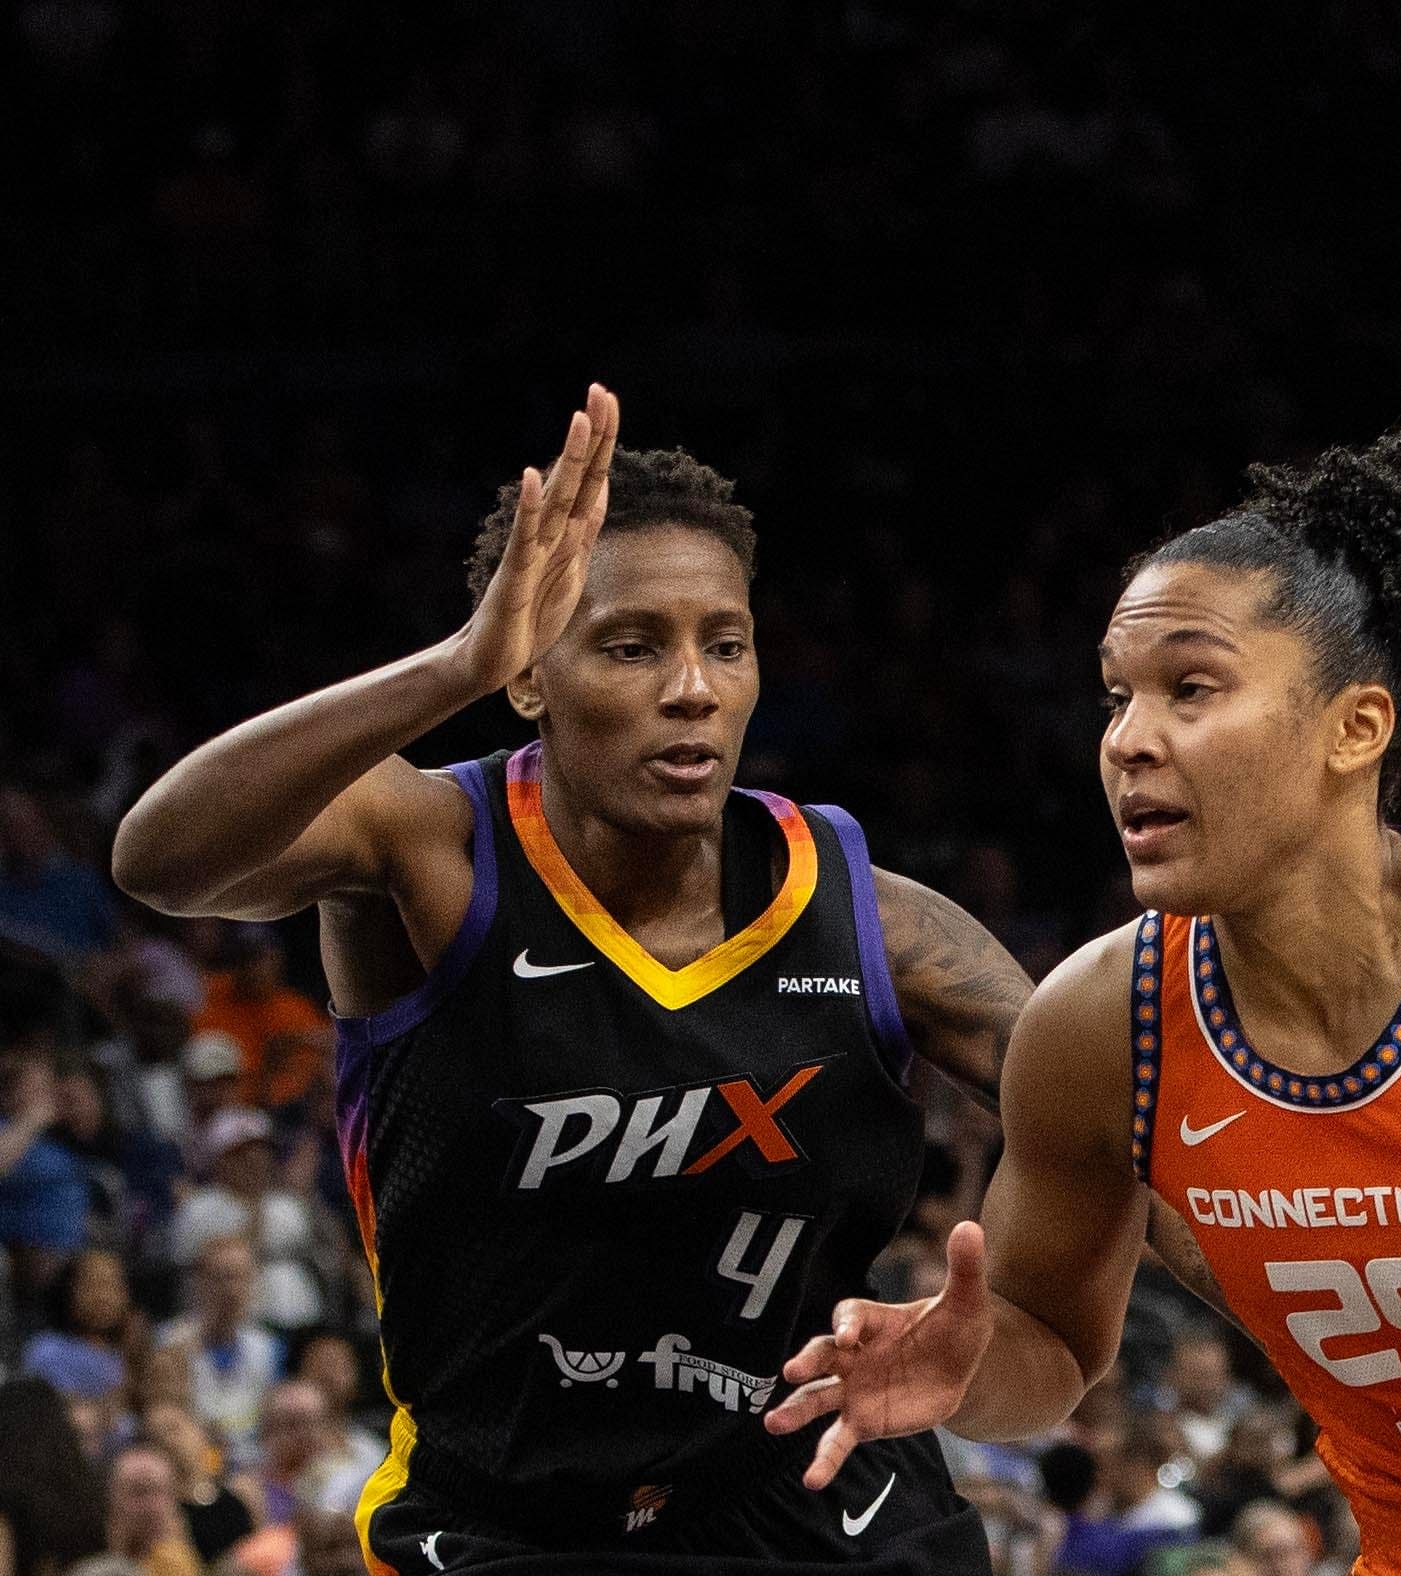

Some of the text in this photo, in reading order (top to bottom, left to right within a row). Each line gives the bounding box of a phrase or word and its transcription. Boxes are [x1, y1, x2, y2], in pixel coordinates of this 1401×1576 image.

[777, 976, 861, 996] PARTAKE
[517, 1064, 824, 1190] PHX
[716, 1211, 807, 1320] 4
[679, 1354, 717, 1372] FOOD
